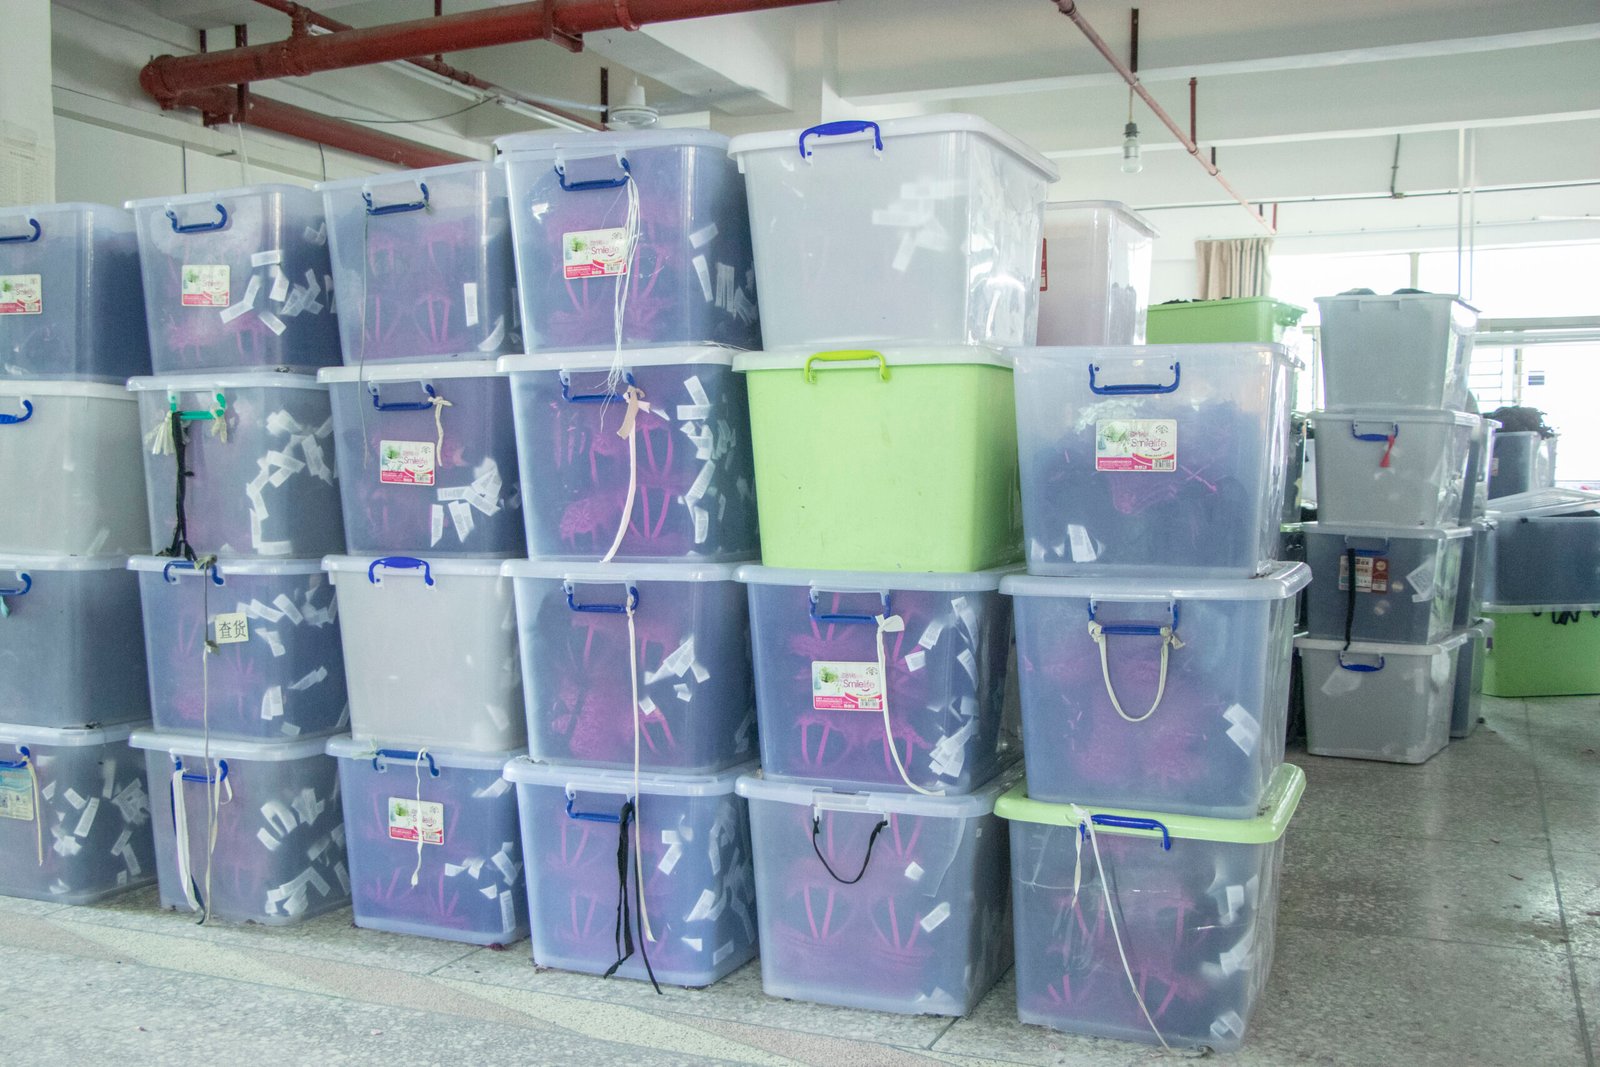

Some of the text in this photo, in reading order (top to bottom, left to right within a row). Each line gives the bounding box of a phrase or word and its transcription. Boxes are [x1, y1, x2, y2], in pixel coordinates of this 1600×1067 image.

[1130, 438, 1168, 448] Smilelife
[218, 620, 247, 639] 查货
[842, 678, 876, 689] Smilelife
